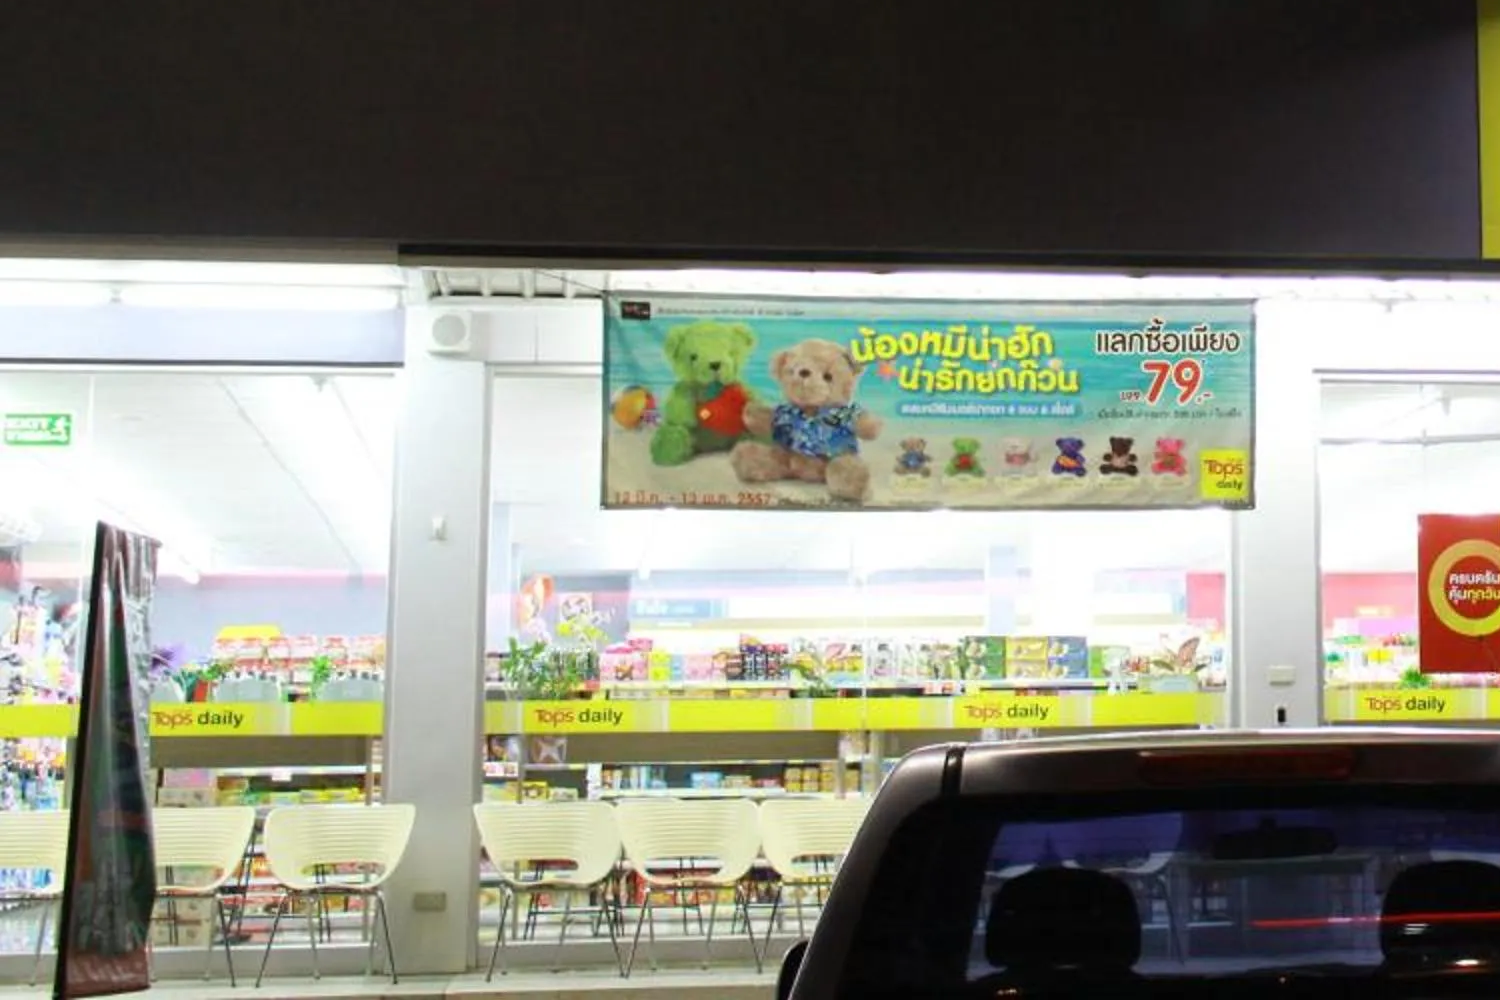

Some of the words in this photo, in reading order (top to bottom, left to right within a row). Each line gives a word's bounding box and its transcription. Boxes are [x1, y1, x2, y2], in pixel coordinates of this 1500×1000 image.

[850, 324, 1053, 363] น้องหมีน่าฮัก
[1096, 318, 1241, 353] แลกซื้อเพียง
[899, 357, 1080, 393] น่ารักยกก๊วน
[1203, 459, 1244, 480] Tops
[963, 705, 1002, 723] Tops
[1007, 703, 1049, 721] daily
[1365, 697, 1401, 713] Tops
[1405, 697, 1446, 713] daily
[152, 711, 193, 729] Tops
[197, 710, 244, 729] daily
[534, 709, 575, 728] Tops
[578, 707, 624, 726] daily
